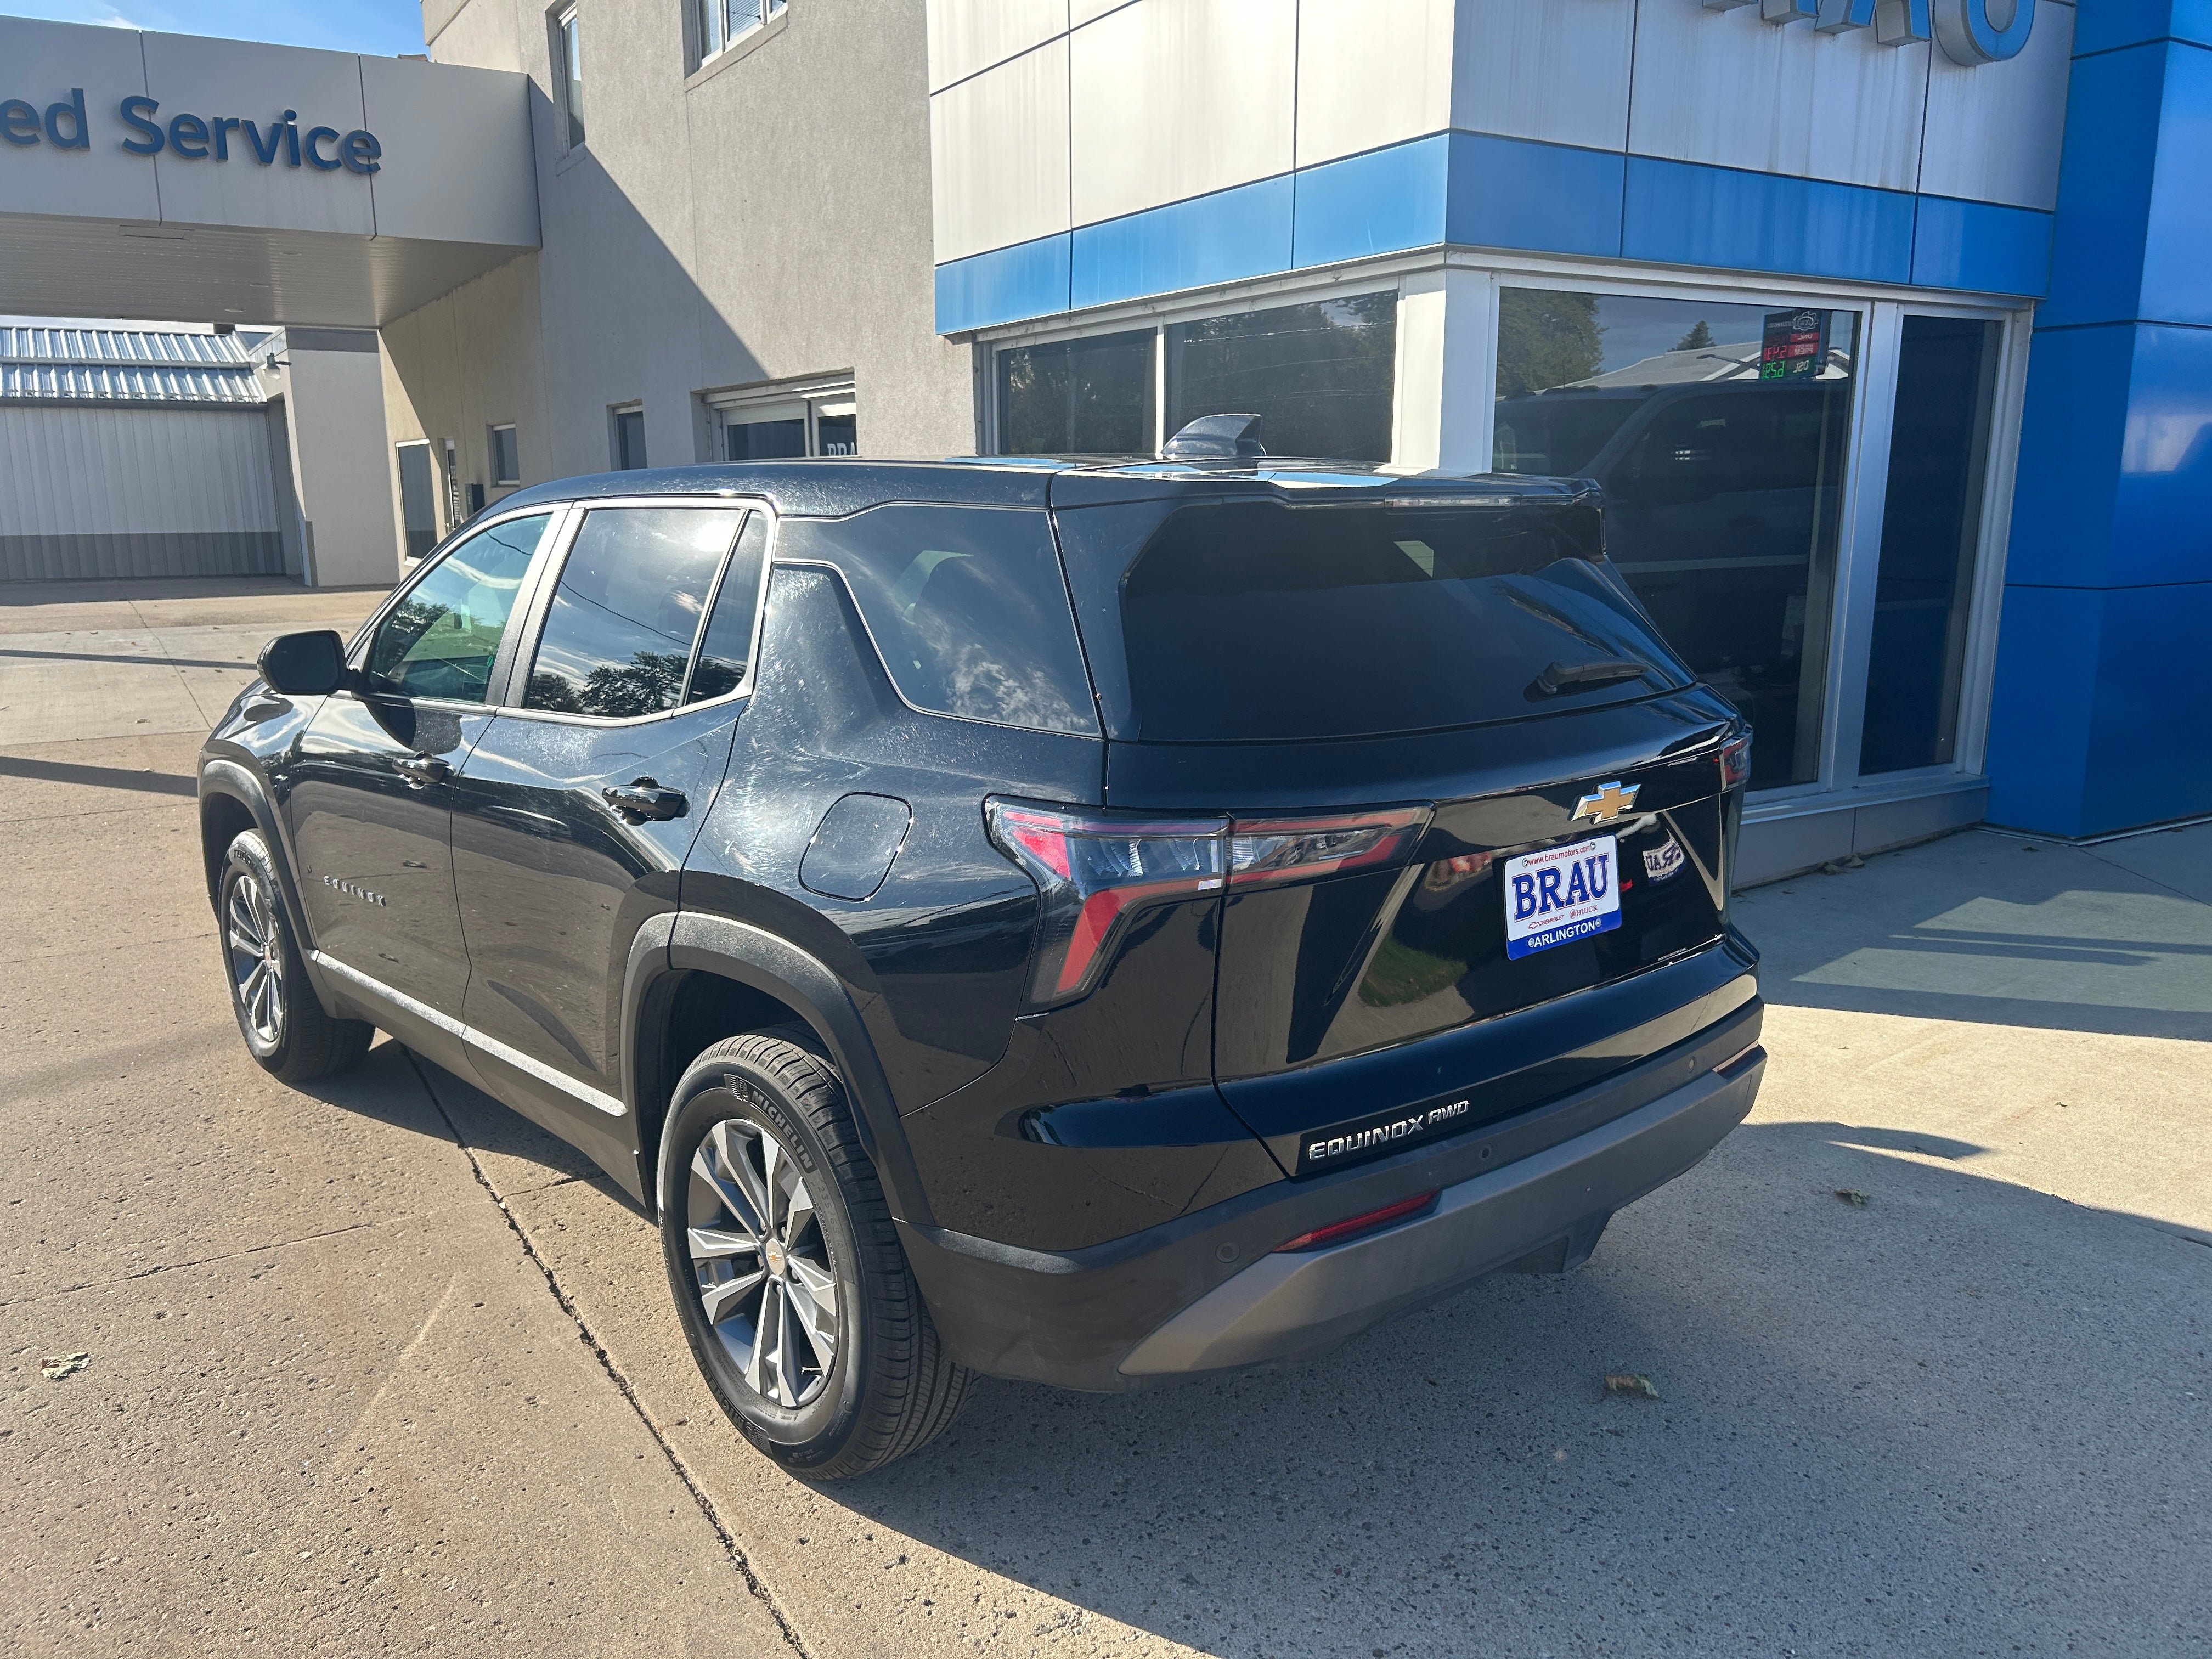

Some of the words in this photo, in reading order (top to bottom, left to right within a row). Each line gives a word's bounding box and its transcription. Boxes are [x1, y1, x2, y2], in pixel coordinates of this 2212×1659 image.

[120, 95, 381, 174] Service
[324, 876, 386, 906] EQUINOX
[1512, 852, 1609, 922] BRAU
[1539, 915, 1564, 927] CHEVROLET
[1576, 905, 1598, 916] BUICK
[1534, 920, 1595, 947] ARLINGTON
[750, 1090, 813, 1169] MICHELIN
[1309, 1115, 1423, 1160] EQUINOX
[1428, 1100, 1469, 1124] AWD
